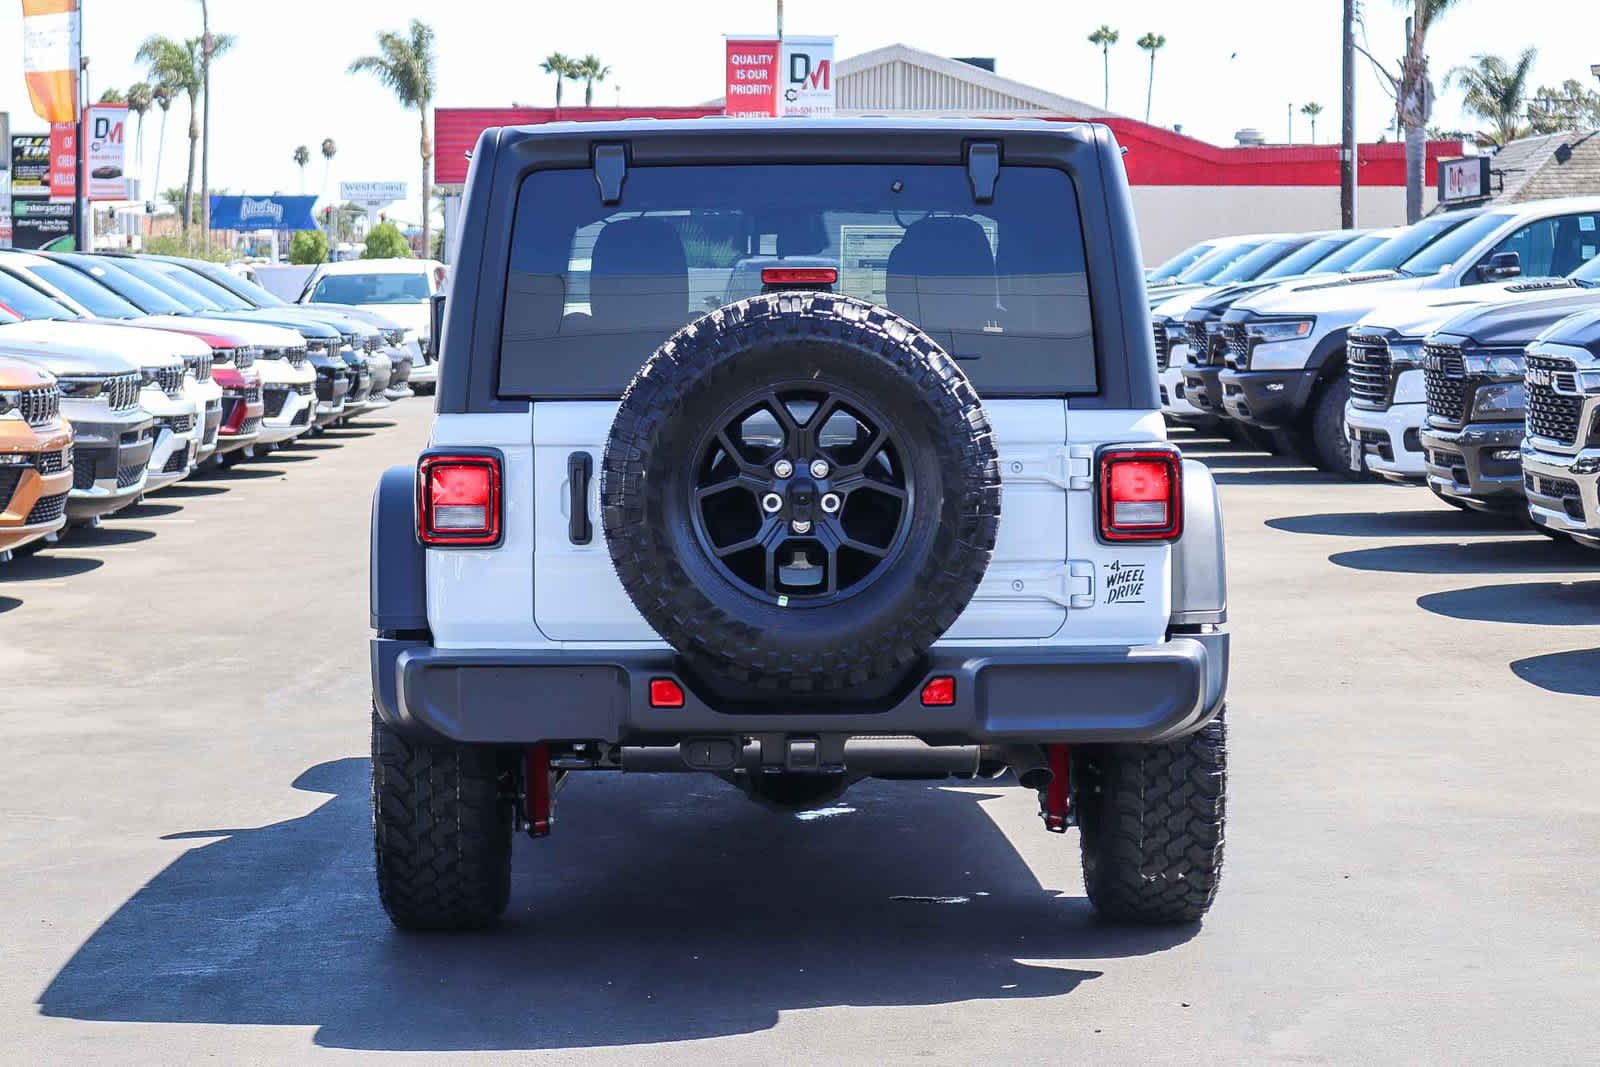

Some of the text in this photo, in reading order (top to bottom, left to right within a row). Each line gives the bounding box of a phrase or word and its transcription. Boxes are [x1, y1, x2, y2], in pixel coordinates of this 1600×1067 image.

[731, 54, 773, 66] QUALITY
[736, 69, 768, 80] IS OUR
[730, 84, 772, 95] PRIORITY
[54, 172, 75, 185] WELCO
[1110, 560, 1120, 571] 4
[1106, 569, 1144, 588] WHEEL
[1107, 582, 1144, 604] DRIVE
